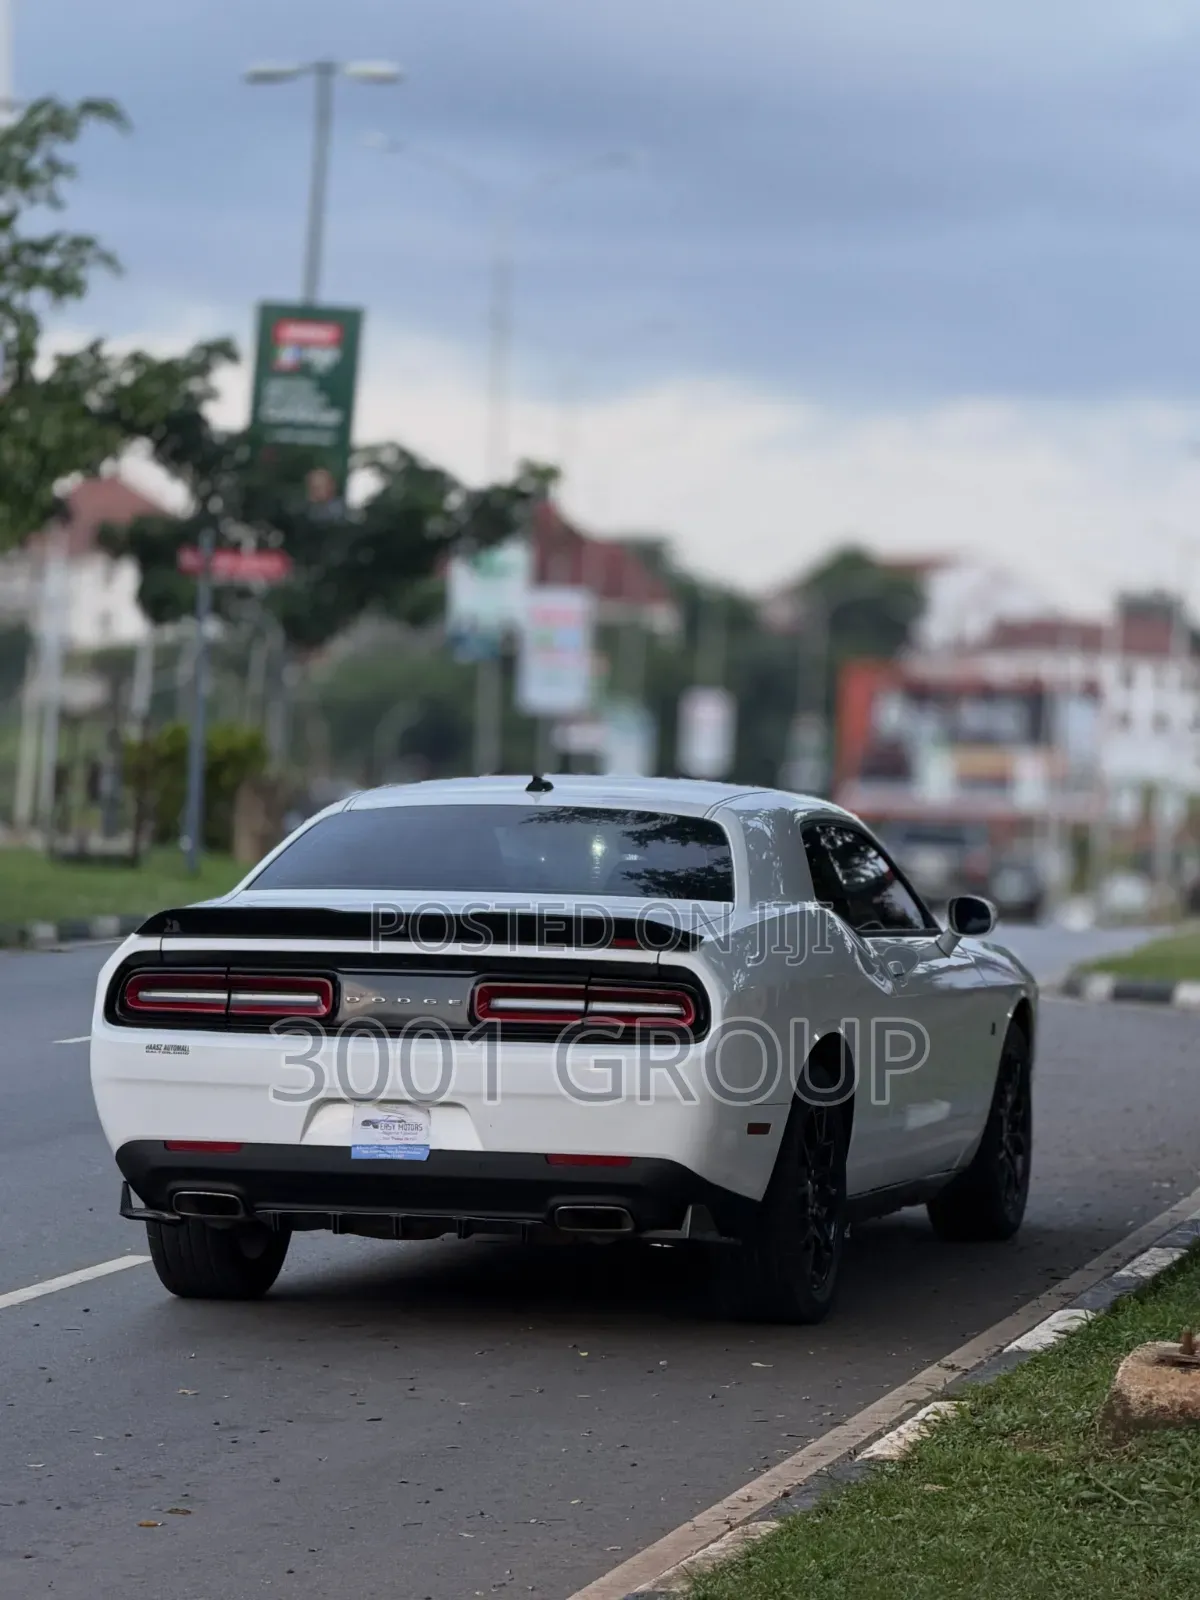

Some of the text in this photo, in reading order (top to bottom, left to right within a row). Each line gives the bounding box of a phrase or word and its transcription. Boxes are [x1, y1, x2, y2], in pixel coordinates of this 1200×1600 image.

[346, 996, 463, 1005] DODGE
[380, 1123, 423, 1131] EASY MOTORS
